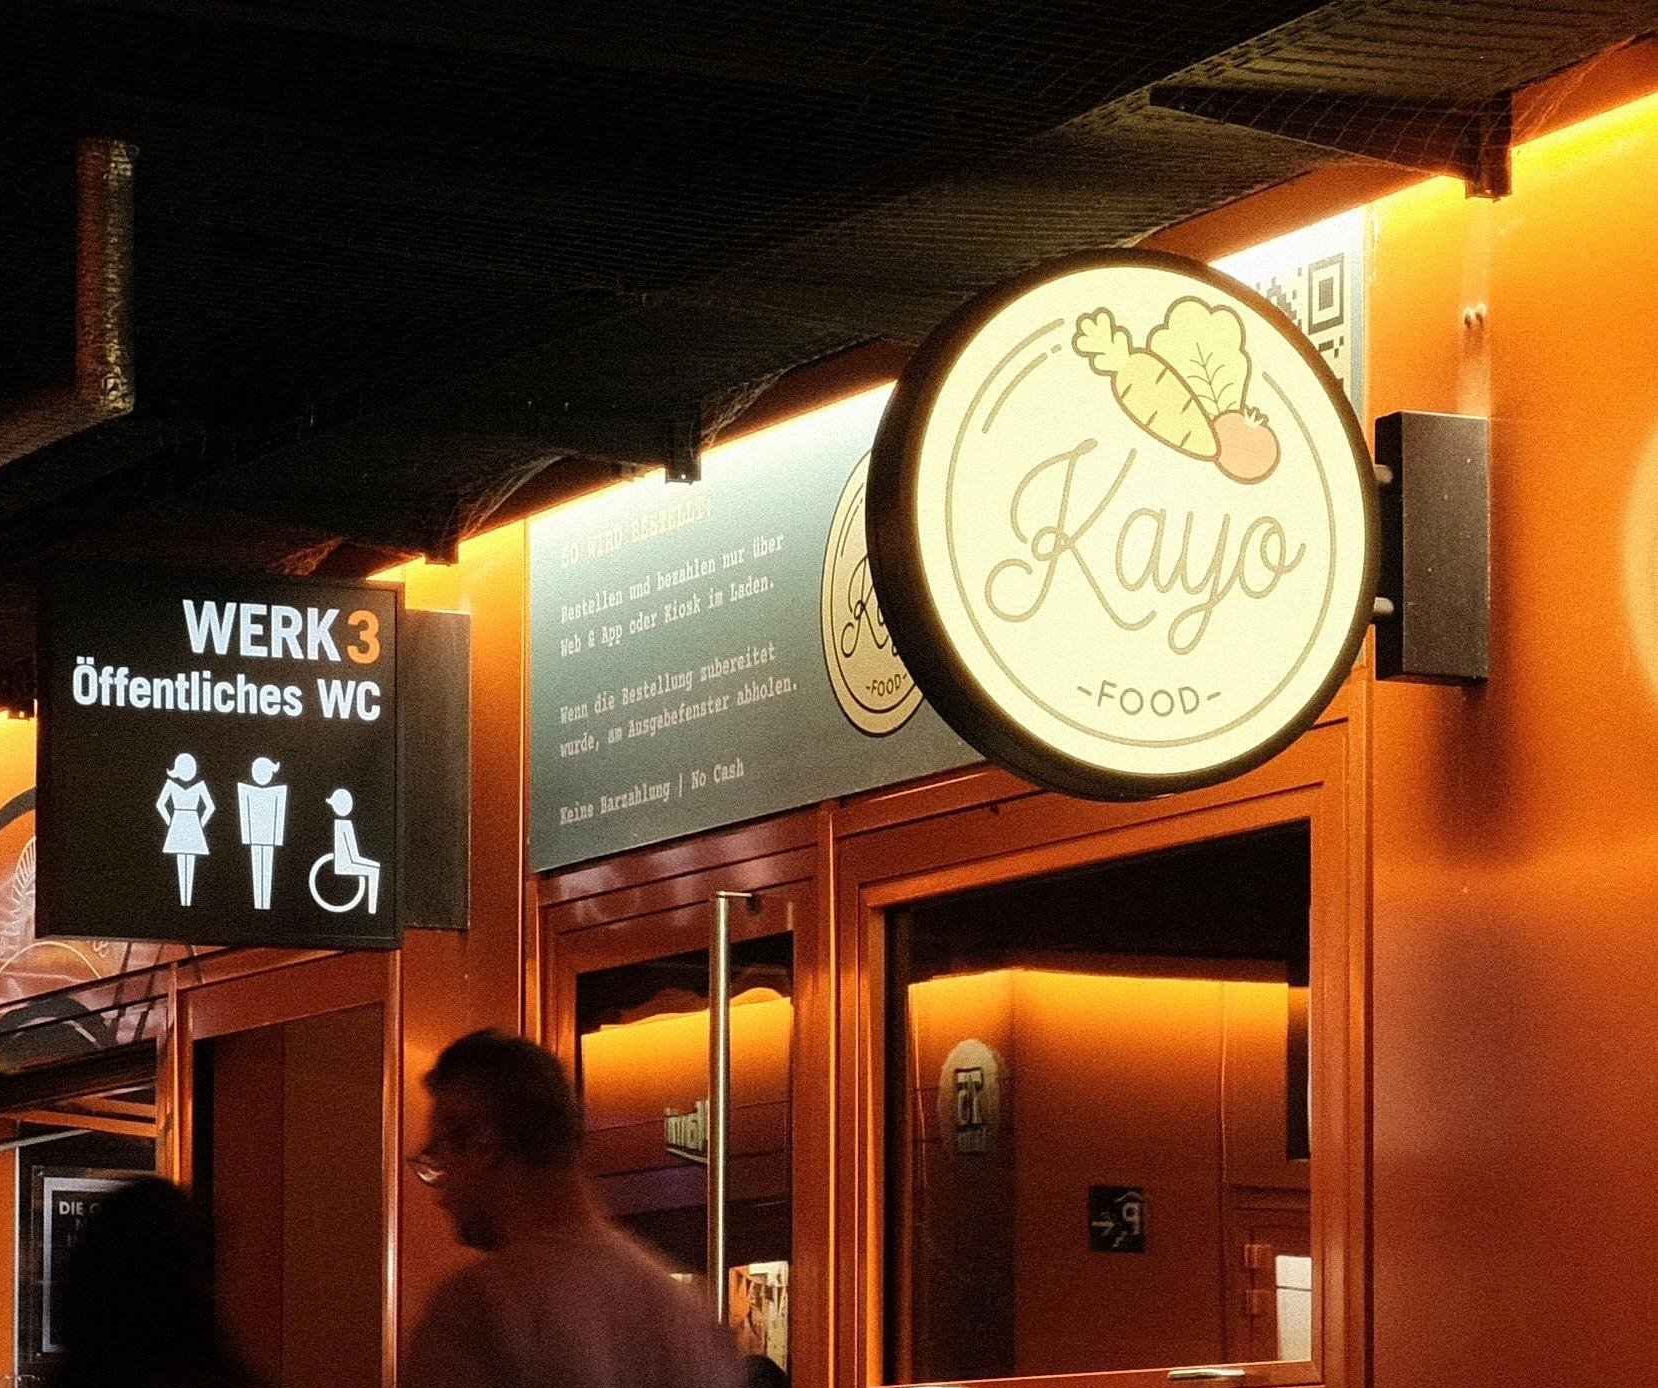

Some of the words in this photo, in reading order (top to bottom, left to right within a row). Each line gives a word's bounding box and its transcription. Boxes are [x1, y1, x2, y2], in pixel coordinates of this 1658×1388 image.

[560, 590, 623, 624] Bestellen
[629, 576, 651, 600] und
[657, 557, 717, 591] bezahlen
[722, 547, 746, 568] nur
[752, 534, 784, 559] über
[982, 437, 1306, 656] Kayo
[560, 634, 582, 657] Web
[601, 623, 623, 647] App
[629, 611, 658, 635] oder
[664, 594, 702, 623] Kiosk
[708, 587, 724, 609] im
[729, 574, 775, 602] Laden.
[73, 656, 303, 717] Öffentliches
[317, 678, 381, 722] WC
[559, 703, 589, 725] Wenn
[594, 692, 615, 714] die
[622, 669, 694, 706] Bestellung
[700, 642, 776, 682] zubereitet
[559, 732, 600, 758] wurde,
[607, 726, 623, 744] am
[628, 693, 730, 737] Ausgebefenster
[736, 676, 798, 707] abholen.
[560, 802, 594, 825] Keine
[600, 781, 671, 815] Barzahlung
[691, 768, 707, 790] No
[713, 757, 744, 783] Cash
[59, 1201, 83, 1216] DIE
